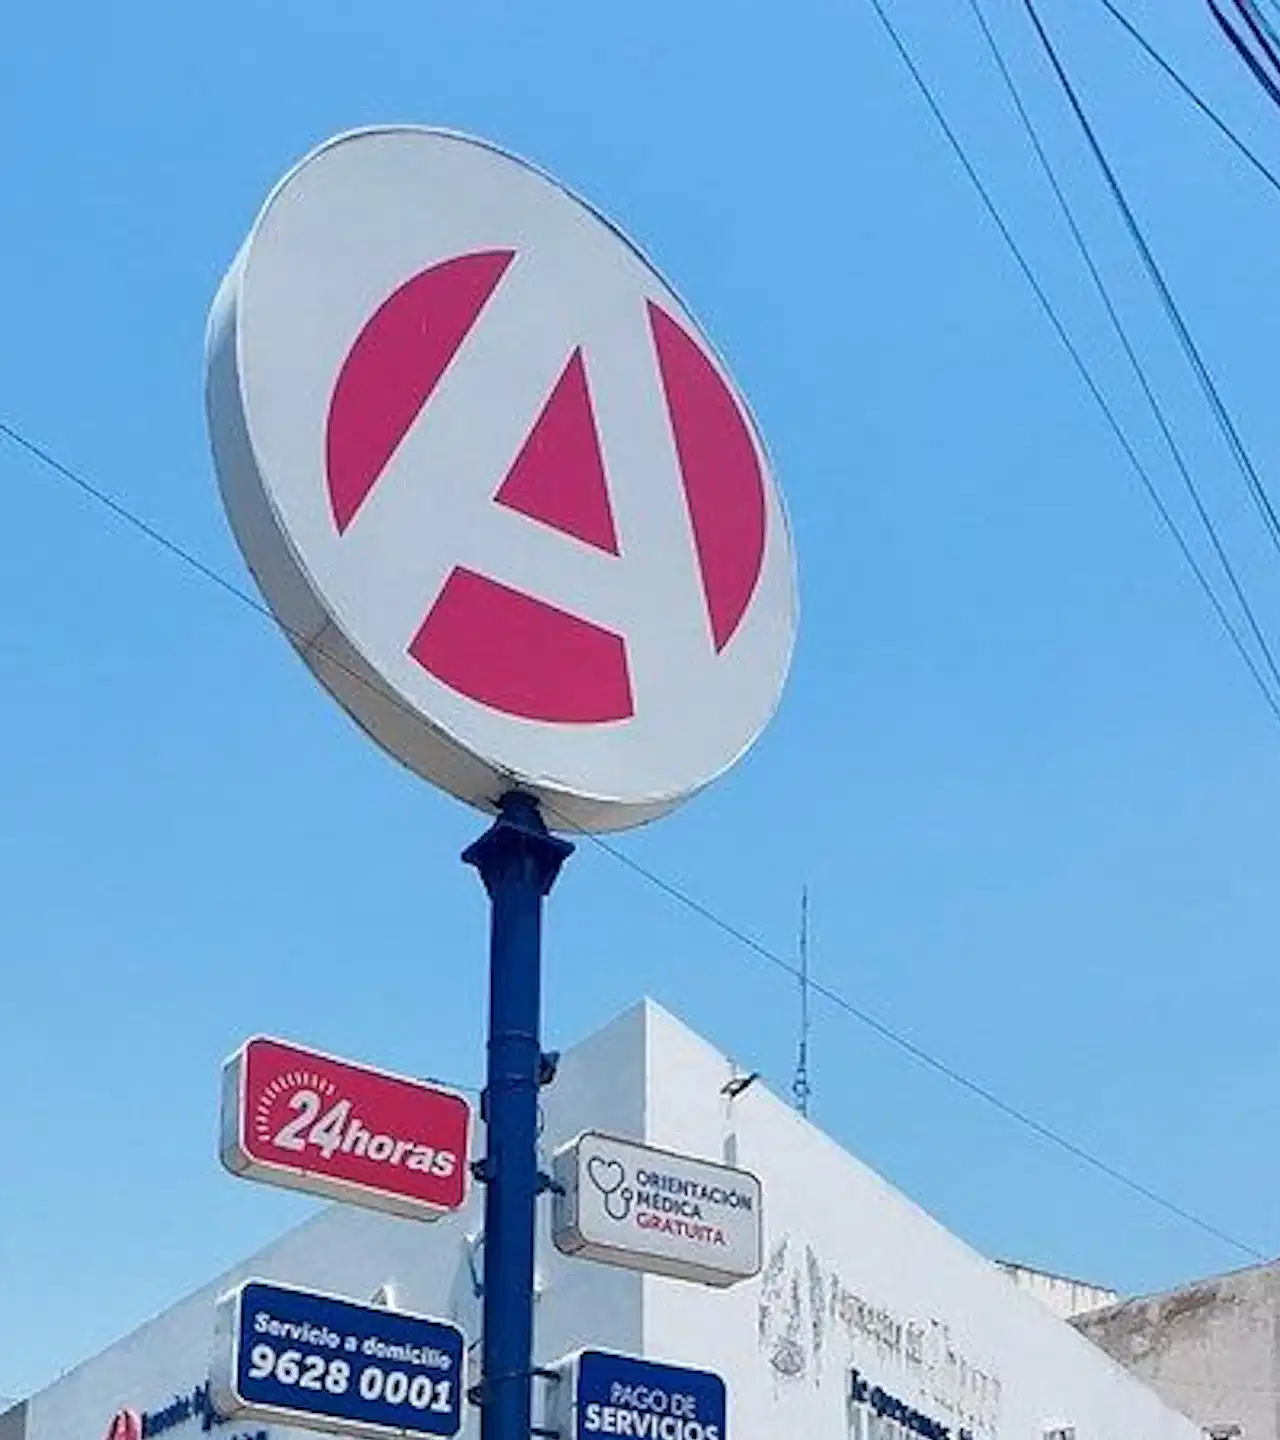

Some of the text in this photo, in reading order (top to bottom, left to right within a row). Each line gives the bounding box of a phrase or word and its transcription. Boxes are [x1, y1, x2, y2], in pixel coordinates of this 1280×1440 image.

[274, 1092, 457, 1178] 24horas
[636, 1169, 753, 1210] ORIENTACIÓN
[636, 1212, 727, 1246] GRATUITA
[253, 1312, 453, 1371] Servicio a domicilio
[247, 1345, 454, 1414] 9628 0001
[609, 1381, 697, 1419] PAGO DE
